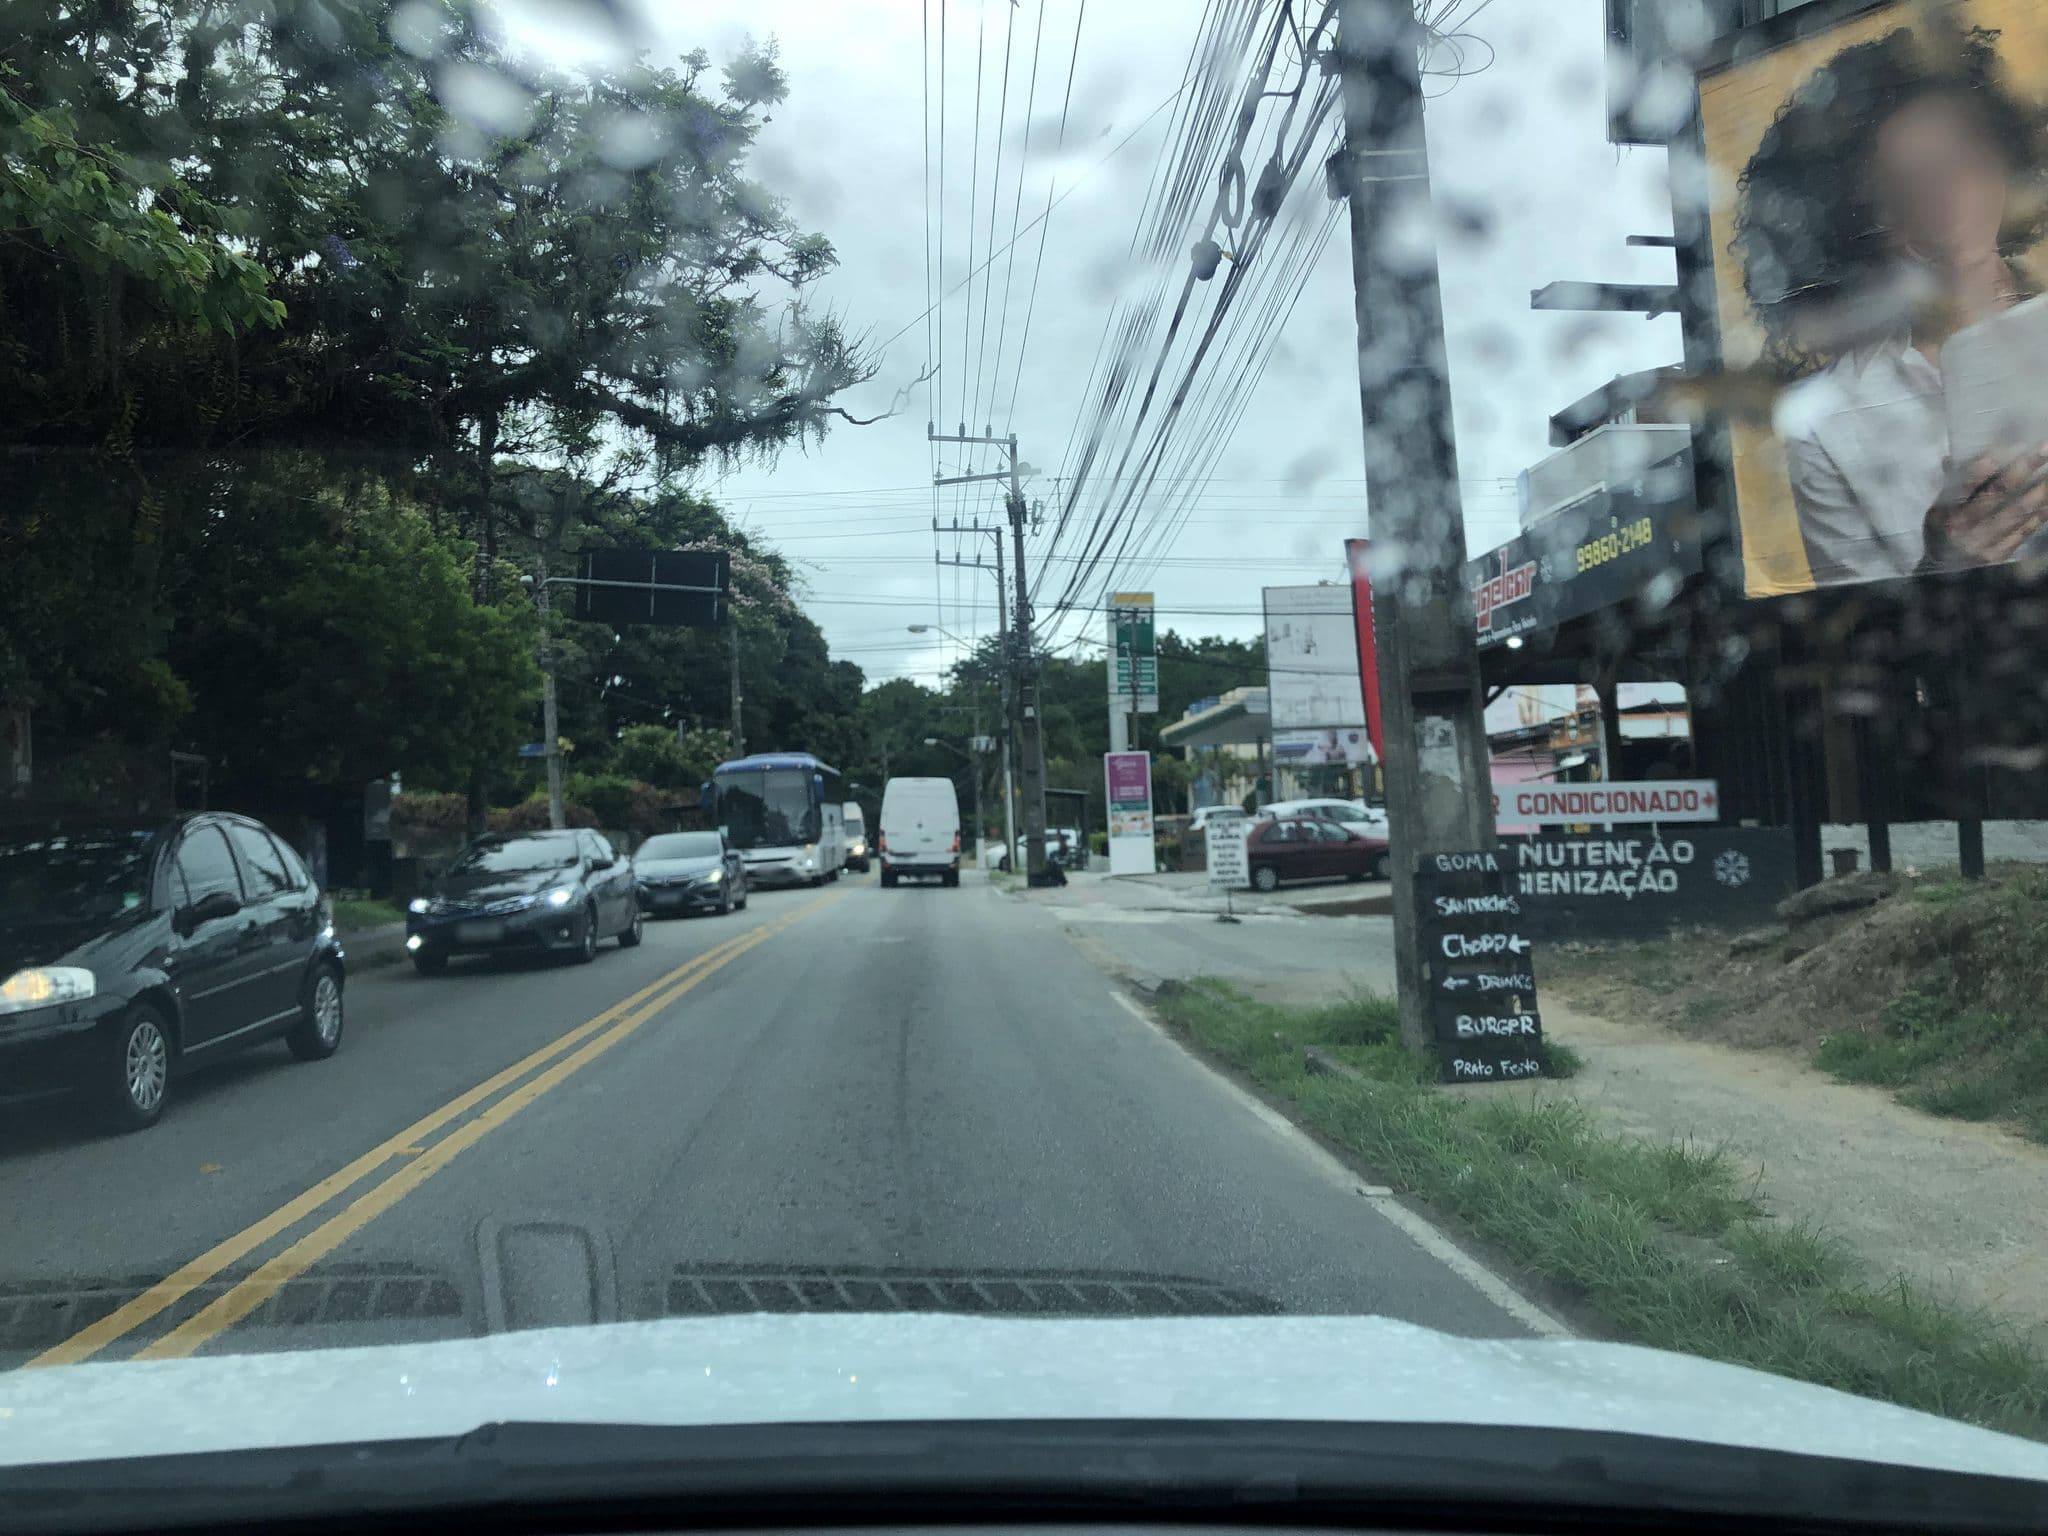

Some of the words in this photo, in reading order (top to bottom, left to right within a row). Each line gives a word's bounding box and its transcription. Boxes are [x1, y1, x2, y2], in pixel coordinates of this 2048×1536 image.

[1577, 517, 1652, 572] 99860-2148
[1517, 789, 1698, 815] CONDICIONADO
[1436, 853, 1498, 872] GOMA
[1499, 838, 1694, 871] NUTENÇÃO
[1519, 866, 1679, 901] IENIZAÇÃO
[1457, 1014, 1536, 1037] BURGER
